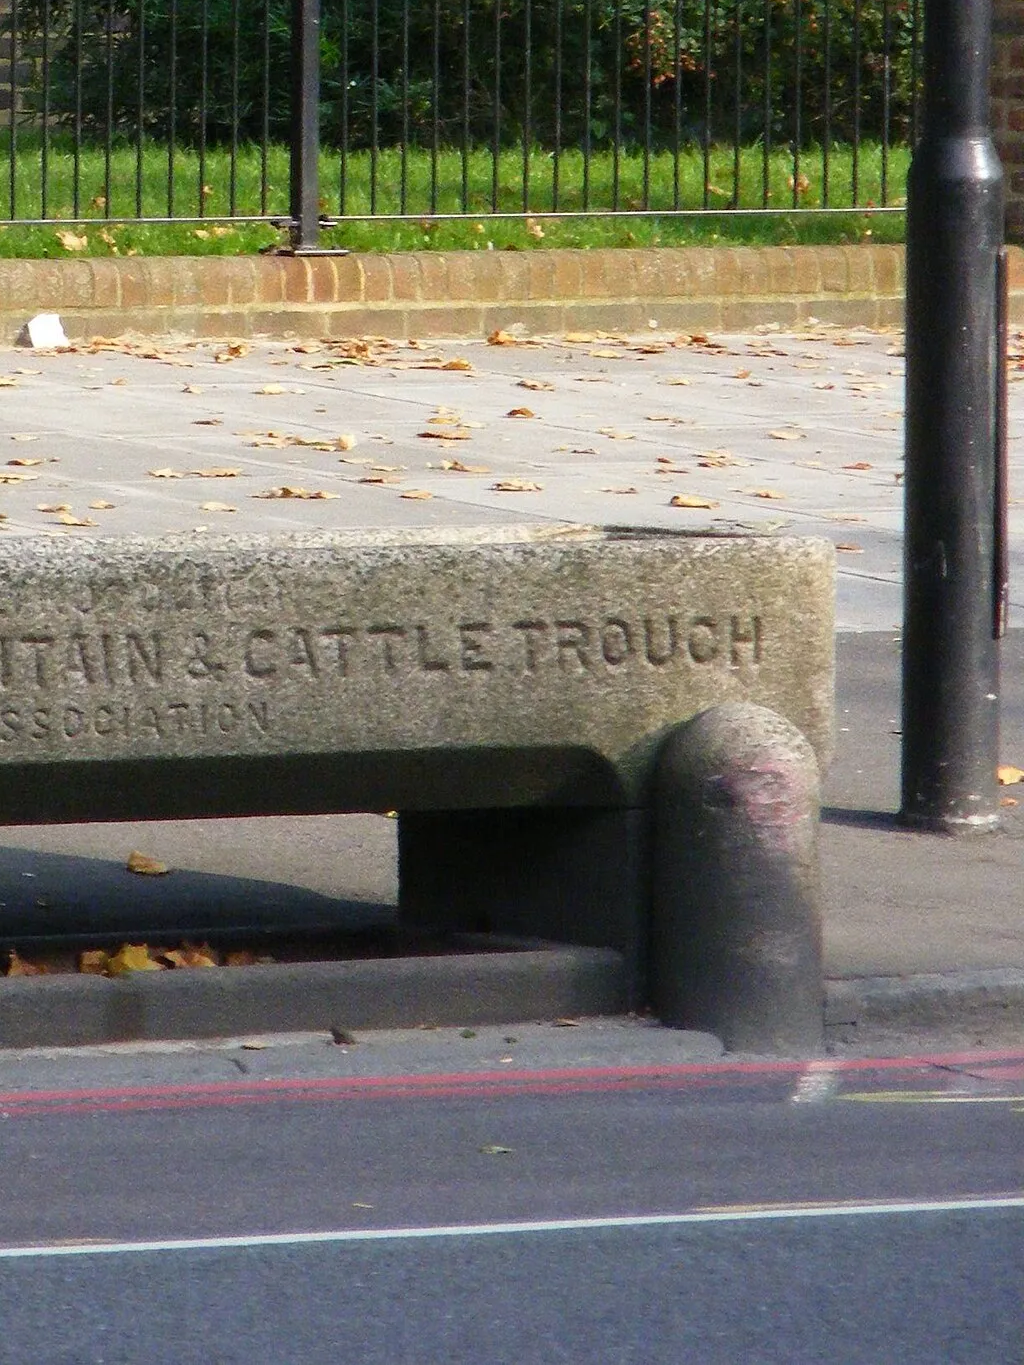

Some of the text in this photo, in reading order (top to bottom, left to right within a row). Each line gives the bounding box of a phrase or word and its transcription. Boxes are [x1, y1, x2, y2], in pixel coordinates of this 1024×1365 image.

[186, 628, 226, 681] &
[244, 621, 495, 679] CATTLE
[511, 614, 764, 674] TROUGH
